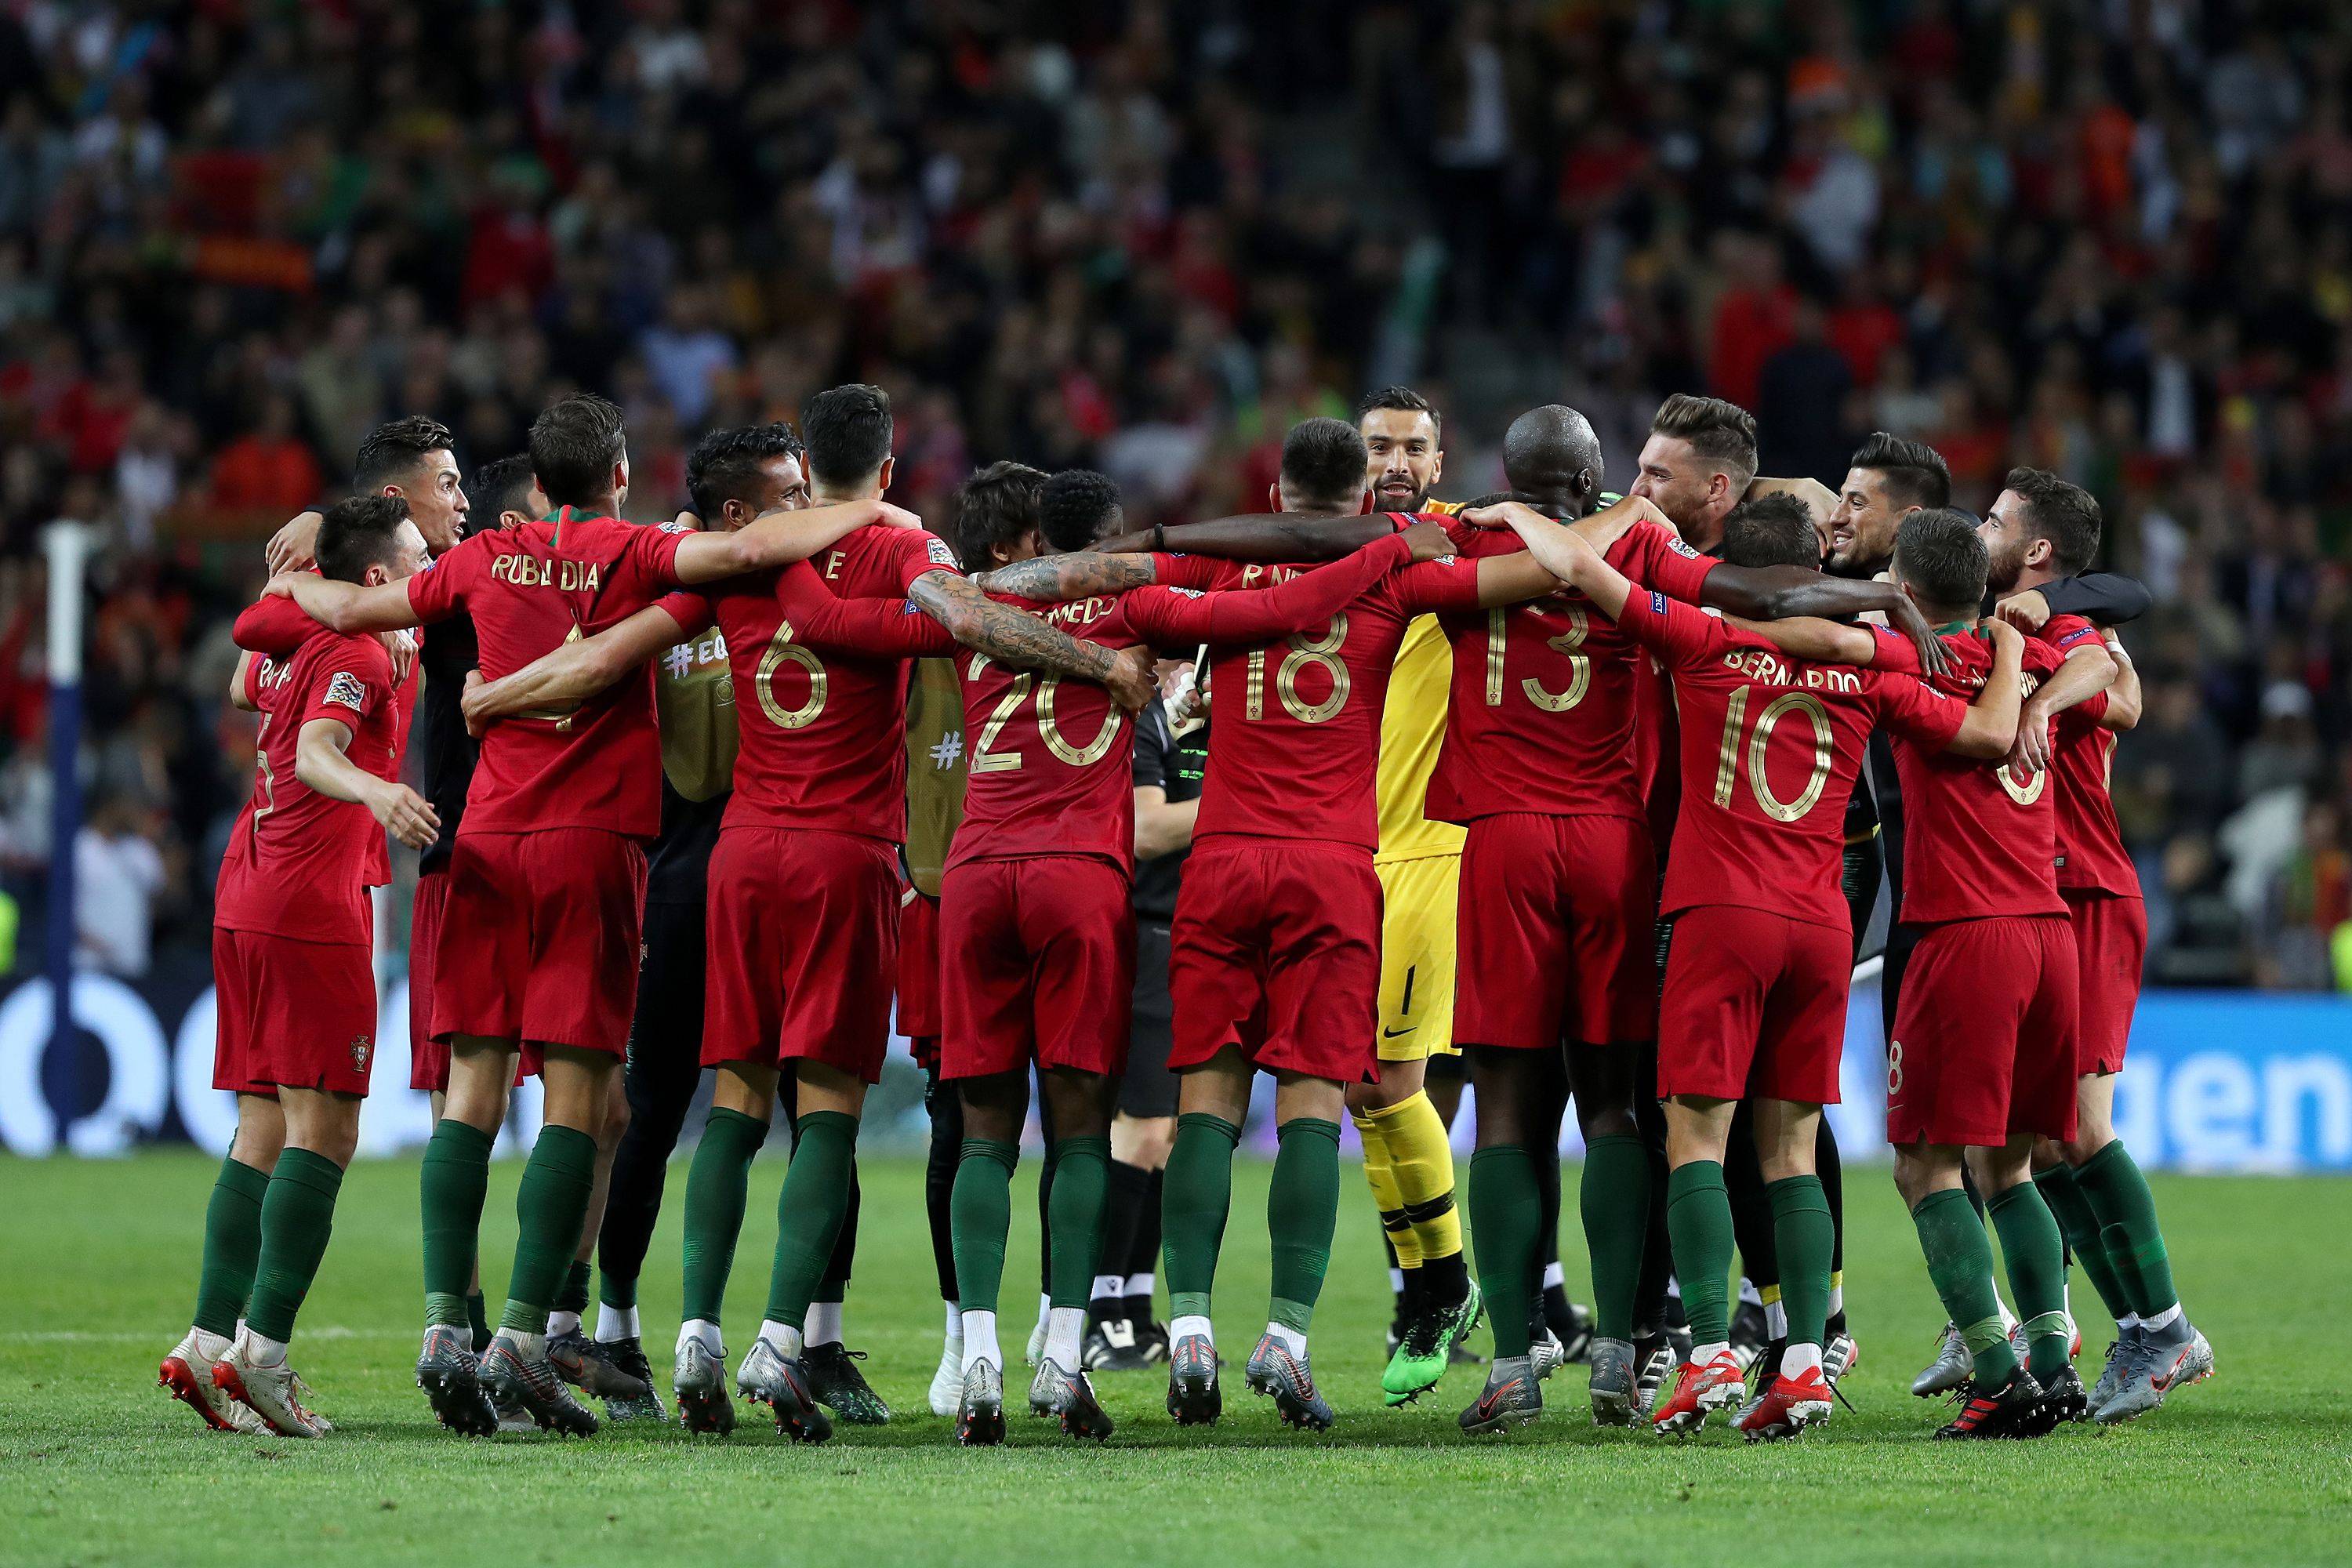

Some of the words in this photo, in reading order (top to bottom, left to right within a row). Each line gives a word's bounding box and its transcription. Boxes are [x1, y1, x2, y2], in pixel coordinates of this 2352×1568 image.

[561, 560, 612, 592] DIA
[756, 619, 828, 729] 6
[968, 639, 1123, 774] 20
[1246, 611, 1351, 724] 18
[1486, 599, 1591, 713] 13
[1714, 684, 1834, 823] 10
[1402, 964, 1415, 1016] 1
[1888, 1040, 1904, 1095] 8
